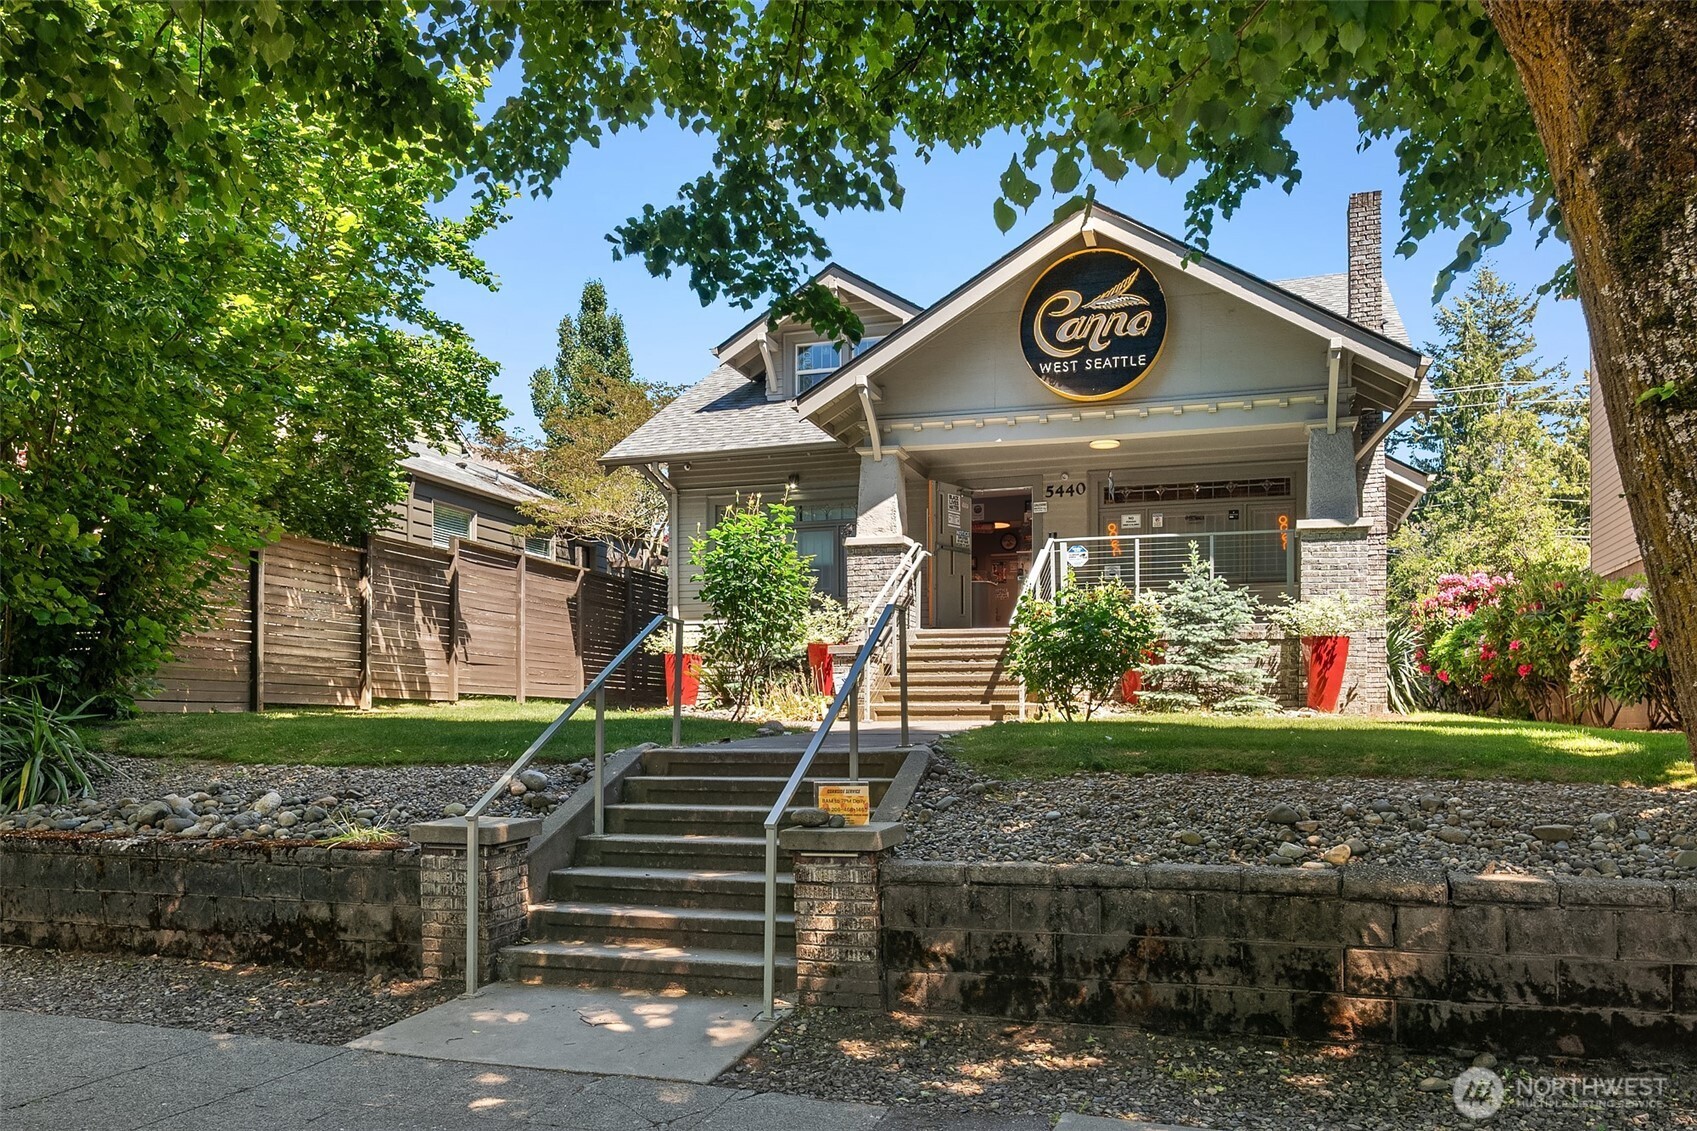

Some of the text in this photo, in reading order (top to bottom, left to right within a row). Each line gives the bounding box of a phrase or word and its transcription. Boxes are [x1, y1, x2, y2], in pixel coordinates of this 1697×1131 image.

[1033, 289, 1153, 358] Canna
[1039, 354, 1147, 374] WEST SEATTLE
[1045, 482, 1087, 498] 5440
